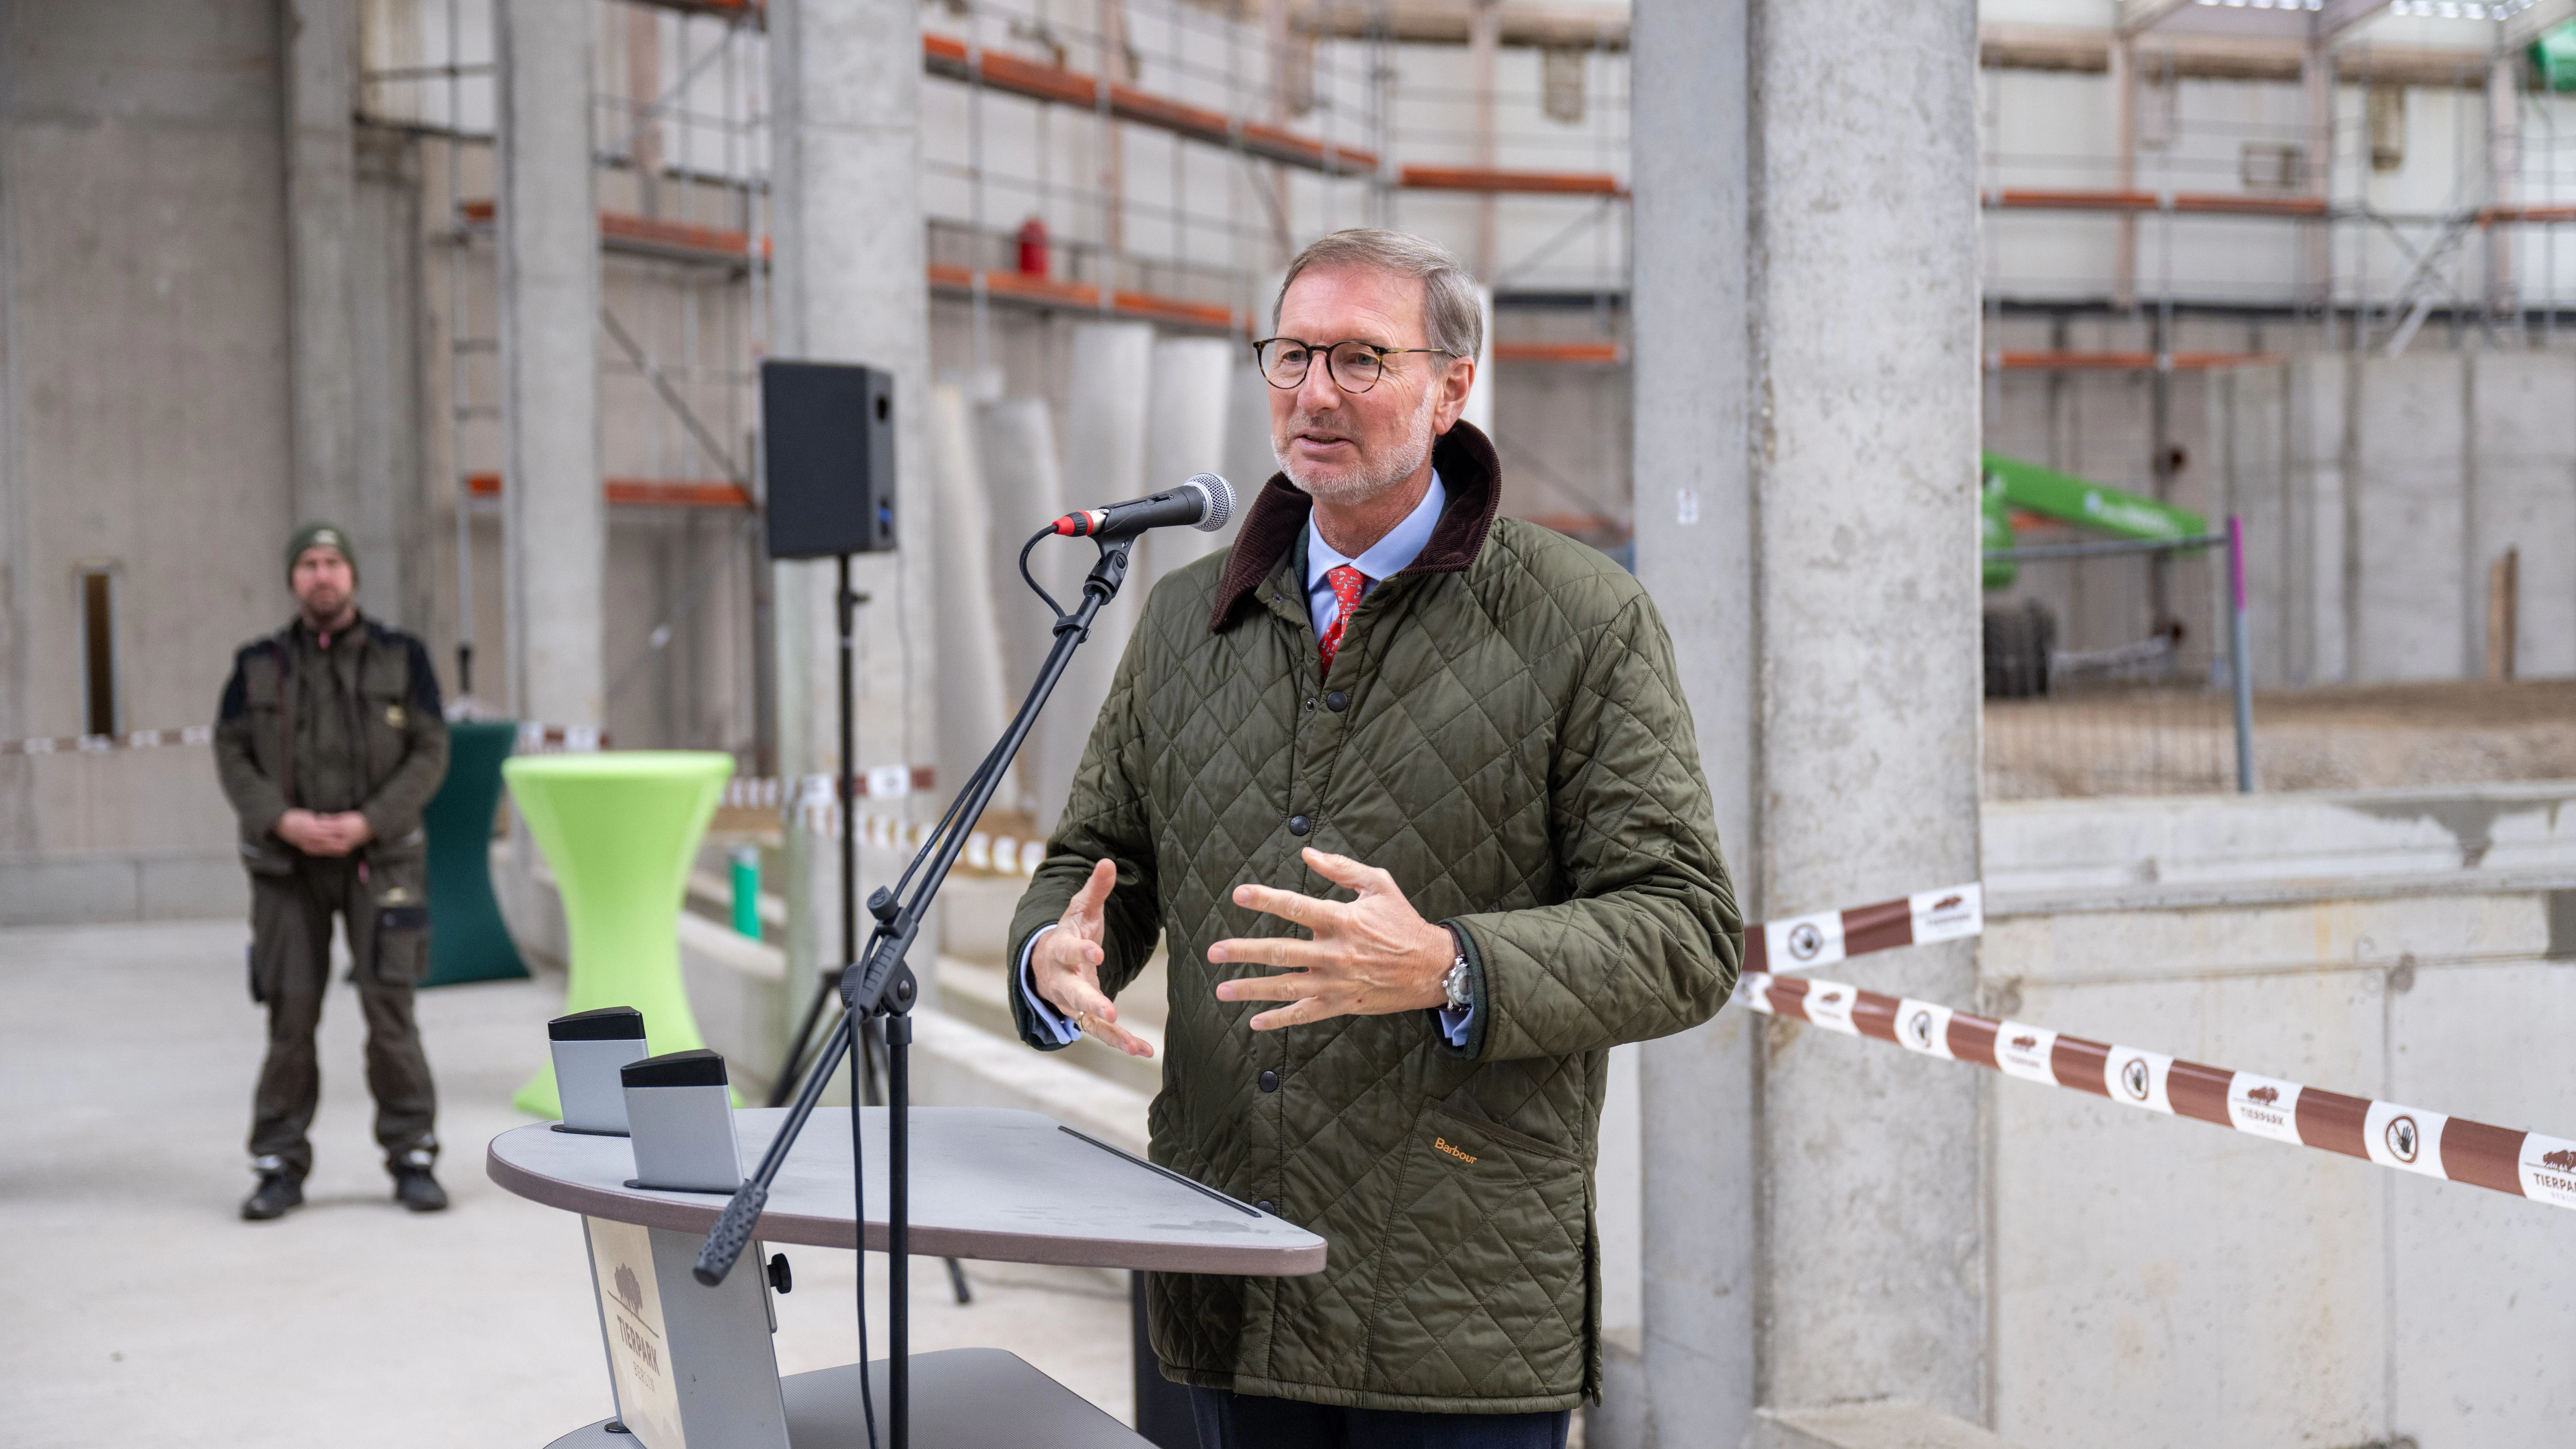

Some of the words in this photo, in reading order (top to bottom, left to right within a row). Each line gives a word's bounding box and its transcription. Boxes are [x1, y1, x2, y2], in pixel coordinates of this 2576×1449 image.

[1434, 1137, 1477, 1164] Barbour
[2533, 1172, 2576, 1194] TIERPA
[617, 1314, 660, 1376] TIERPARK
[633, 1361, 655, 1393] BERLIN
